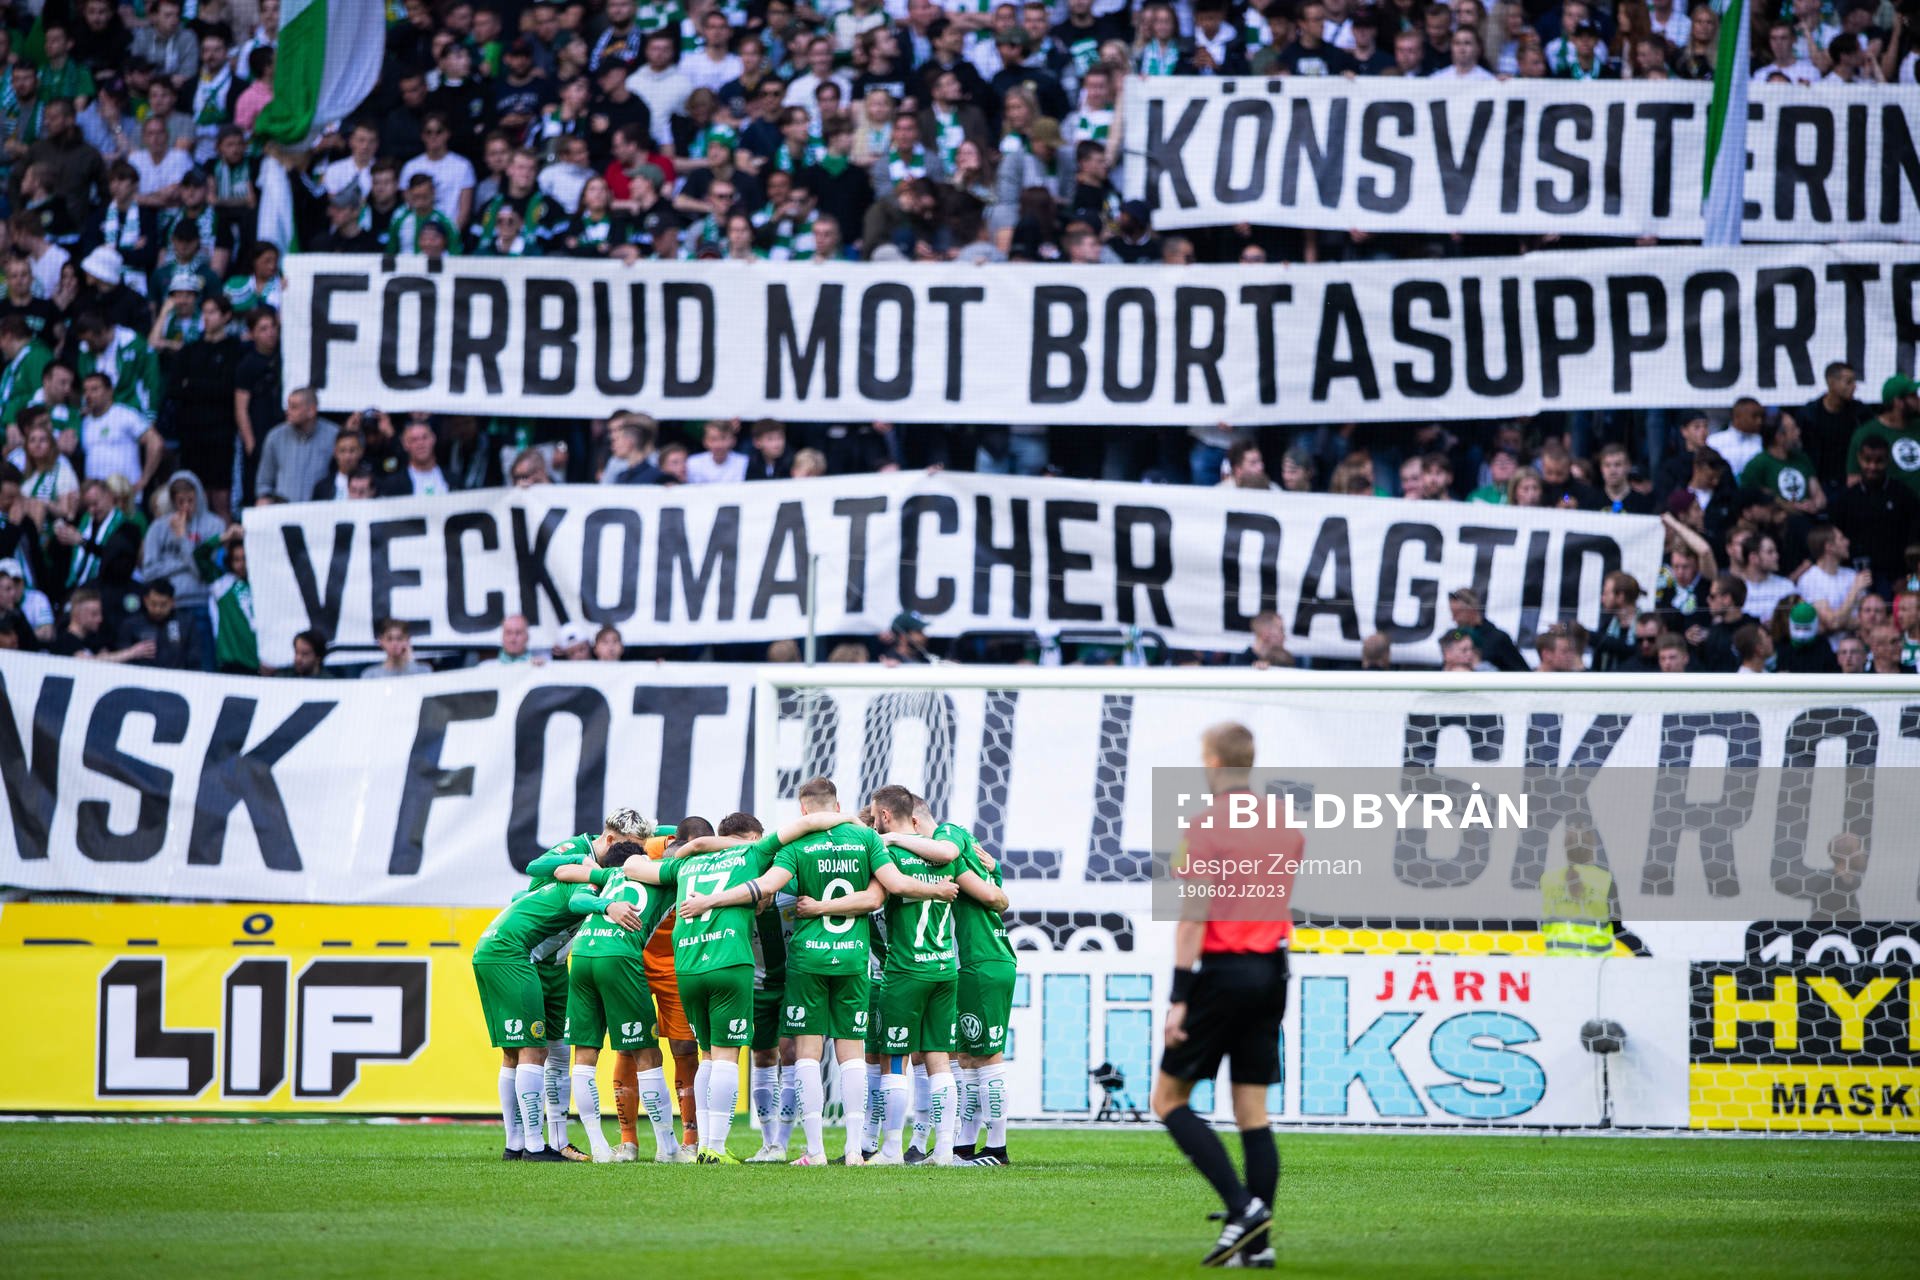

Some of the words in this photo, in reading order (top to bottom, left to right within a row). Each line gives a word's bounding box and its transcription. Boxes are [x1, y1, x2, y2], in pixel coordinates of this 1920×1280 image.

[310, 256, 716, 398] FÖRBUD
[765, 283, 985, 402] MOT
[281, 494, 1174, 640] VECKOMATCHER
[817, 859, 860, 873] BOJANIC
[700, 930, 722, 943] LINE
[805, 939, 831, 949] SILJA
[832, 940, 855, 949] LINE
[1376, 962, 1531, 1002] JÄRN
[96, 957, 430, 1099] LIP
[1713, 975, 1920, 1050] HY
[522, 1091, 540, 1127] Clinton
[988, 1079, 1005, 1119] Clinton
[1771, 1082, 1914, 1118] MASK
